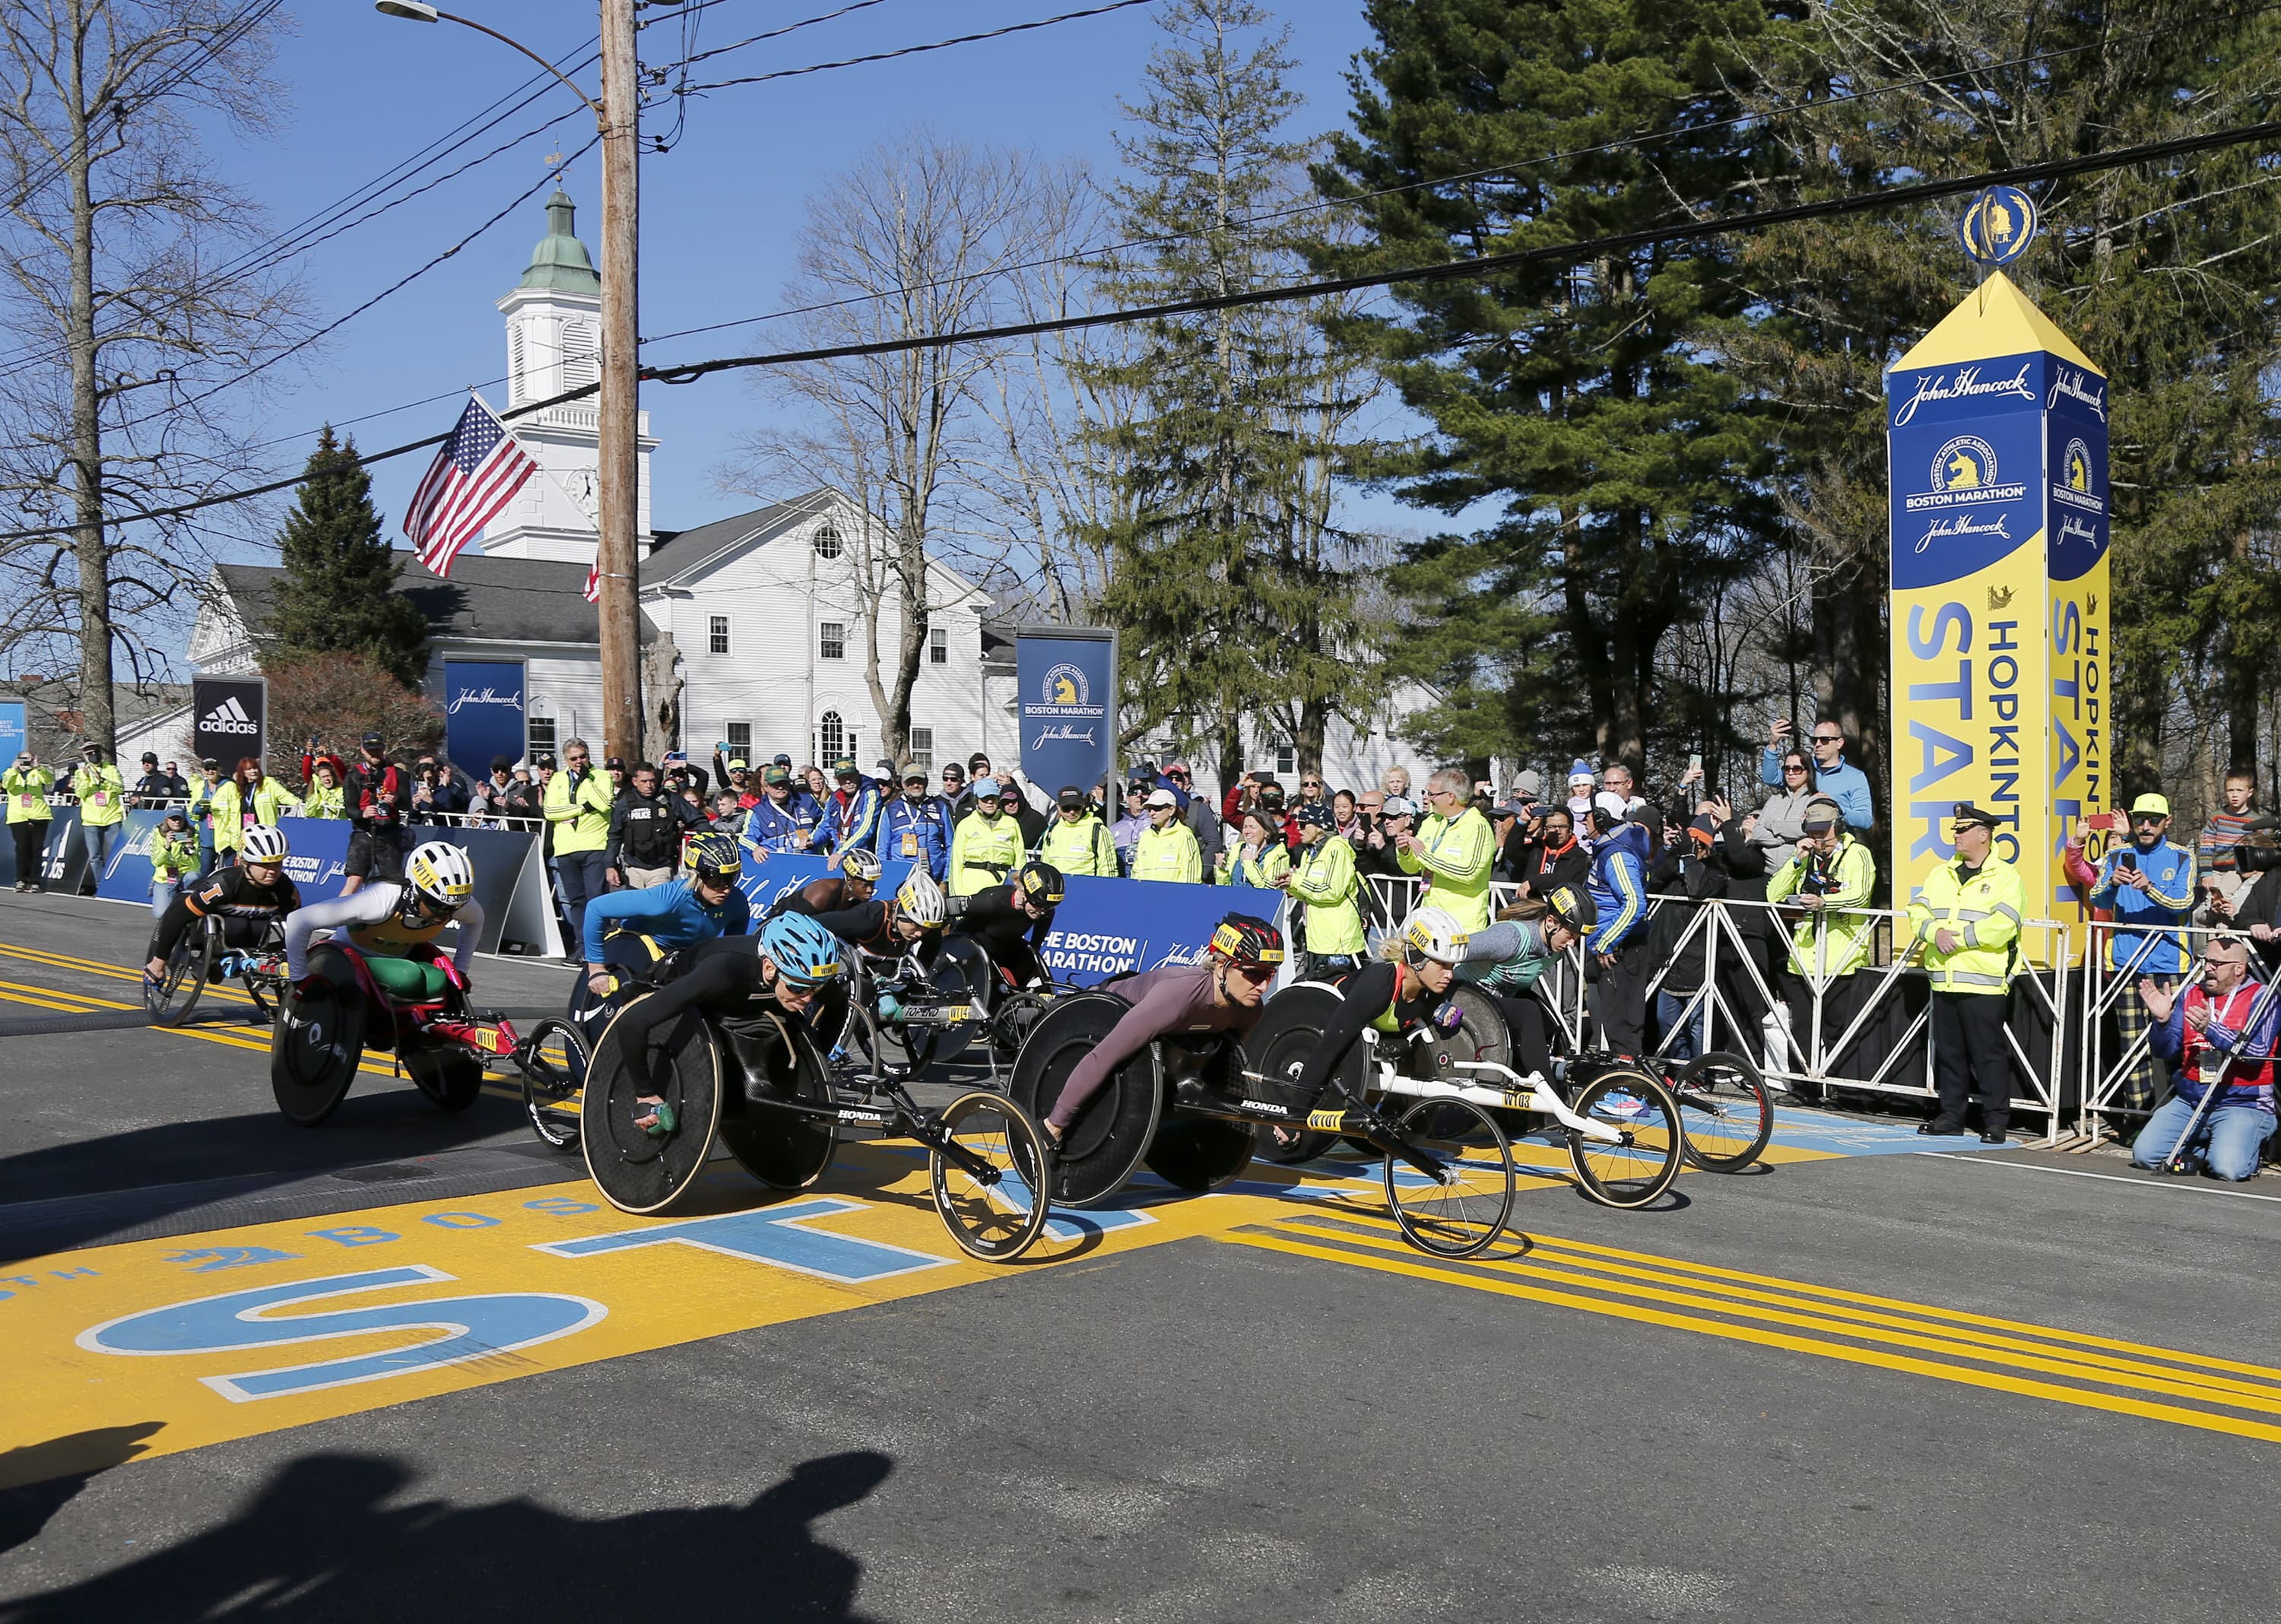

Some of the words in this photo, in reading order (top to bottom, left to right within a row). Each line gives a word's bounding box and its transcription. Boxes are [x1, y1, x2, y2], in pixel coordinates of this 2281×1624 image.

[1894, 374, 1950, 427] John
[1948, 363, 2036, 401] Hancock
[2047, 364, 2072, 410] John
[2070, 371, 2105, 423] Hancock
[1934, 457, 1943, 488] BOSTON
[1940, 438, 1972, 458] ATHLETIC
[1971, 439, 1994, 483] ASSOCIATION
[1906, 493, 1953, 509] BOSTON
[1955, 487, 2023, 503] MARATHON
[2053, 487, 2074, 502] BOSTON
[2074, 493, 2103, 511] MARATHON
[1915, 519, 1953, 553] John
[1951, 513, 2011, 539] Hancock
[2057, 514, 2075, 545] John
[449, 687, 481, 714] John
[478, 687, 523, 711] Hancock
[625, 696, 633, 705] 2
[1025, 706, 1059, 715] BOSTON
[1061, 706, 1102, 715] MARATHON
[199, 719, 257, 734] adidas
[1032, 725, 1062, 750] John
[1059, 725, 1096, 747] Hancock
[1908, 601, 1975, 899] STAR
[1988, 620, 2020, 864] HOPKINTO
[630, 810, 652, 820] POLICE
[289, 856, 320, 870] BOSTON
[414, 861, 433, 886] W111
[1554, 890, 1572, 910] W105
[1041, 931, 1064, 948] HE
[1064, 932, 1137, 955] BOSTON
[1215, 928, 1236, 950] W101
[1410, 924, 1429, 948] W103
[1041, 950, 1134, 974] ARATHON
[906, 1007, 922, 1017] TOP
[950, 1007, 968, 1019] W114
[477, 1030, 494, 1047] W111
[553, 1026, 586, 1068] CORIMA
[1240, 1099, 1289, 1115] HONDA
[1504, 1093, 1531, 1109] W103
[529, 1102, 563, 1145] CORIMA
[838, 1110, 881, 1121] HONDA
[1312, 1113, 1339, 1128] W101
